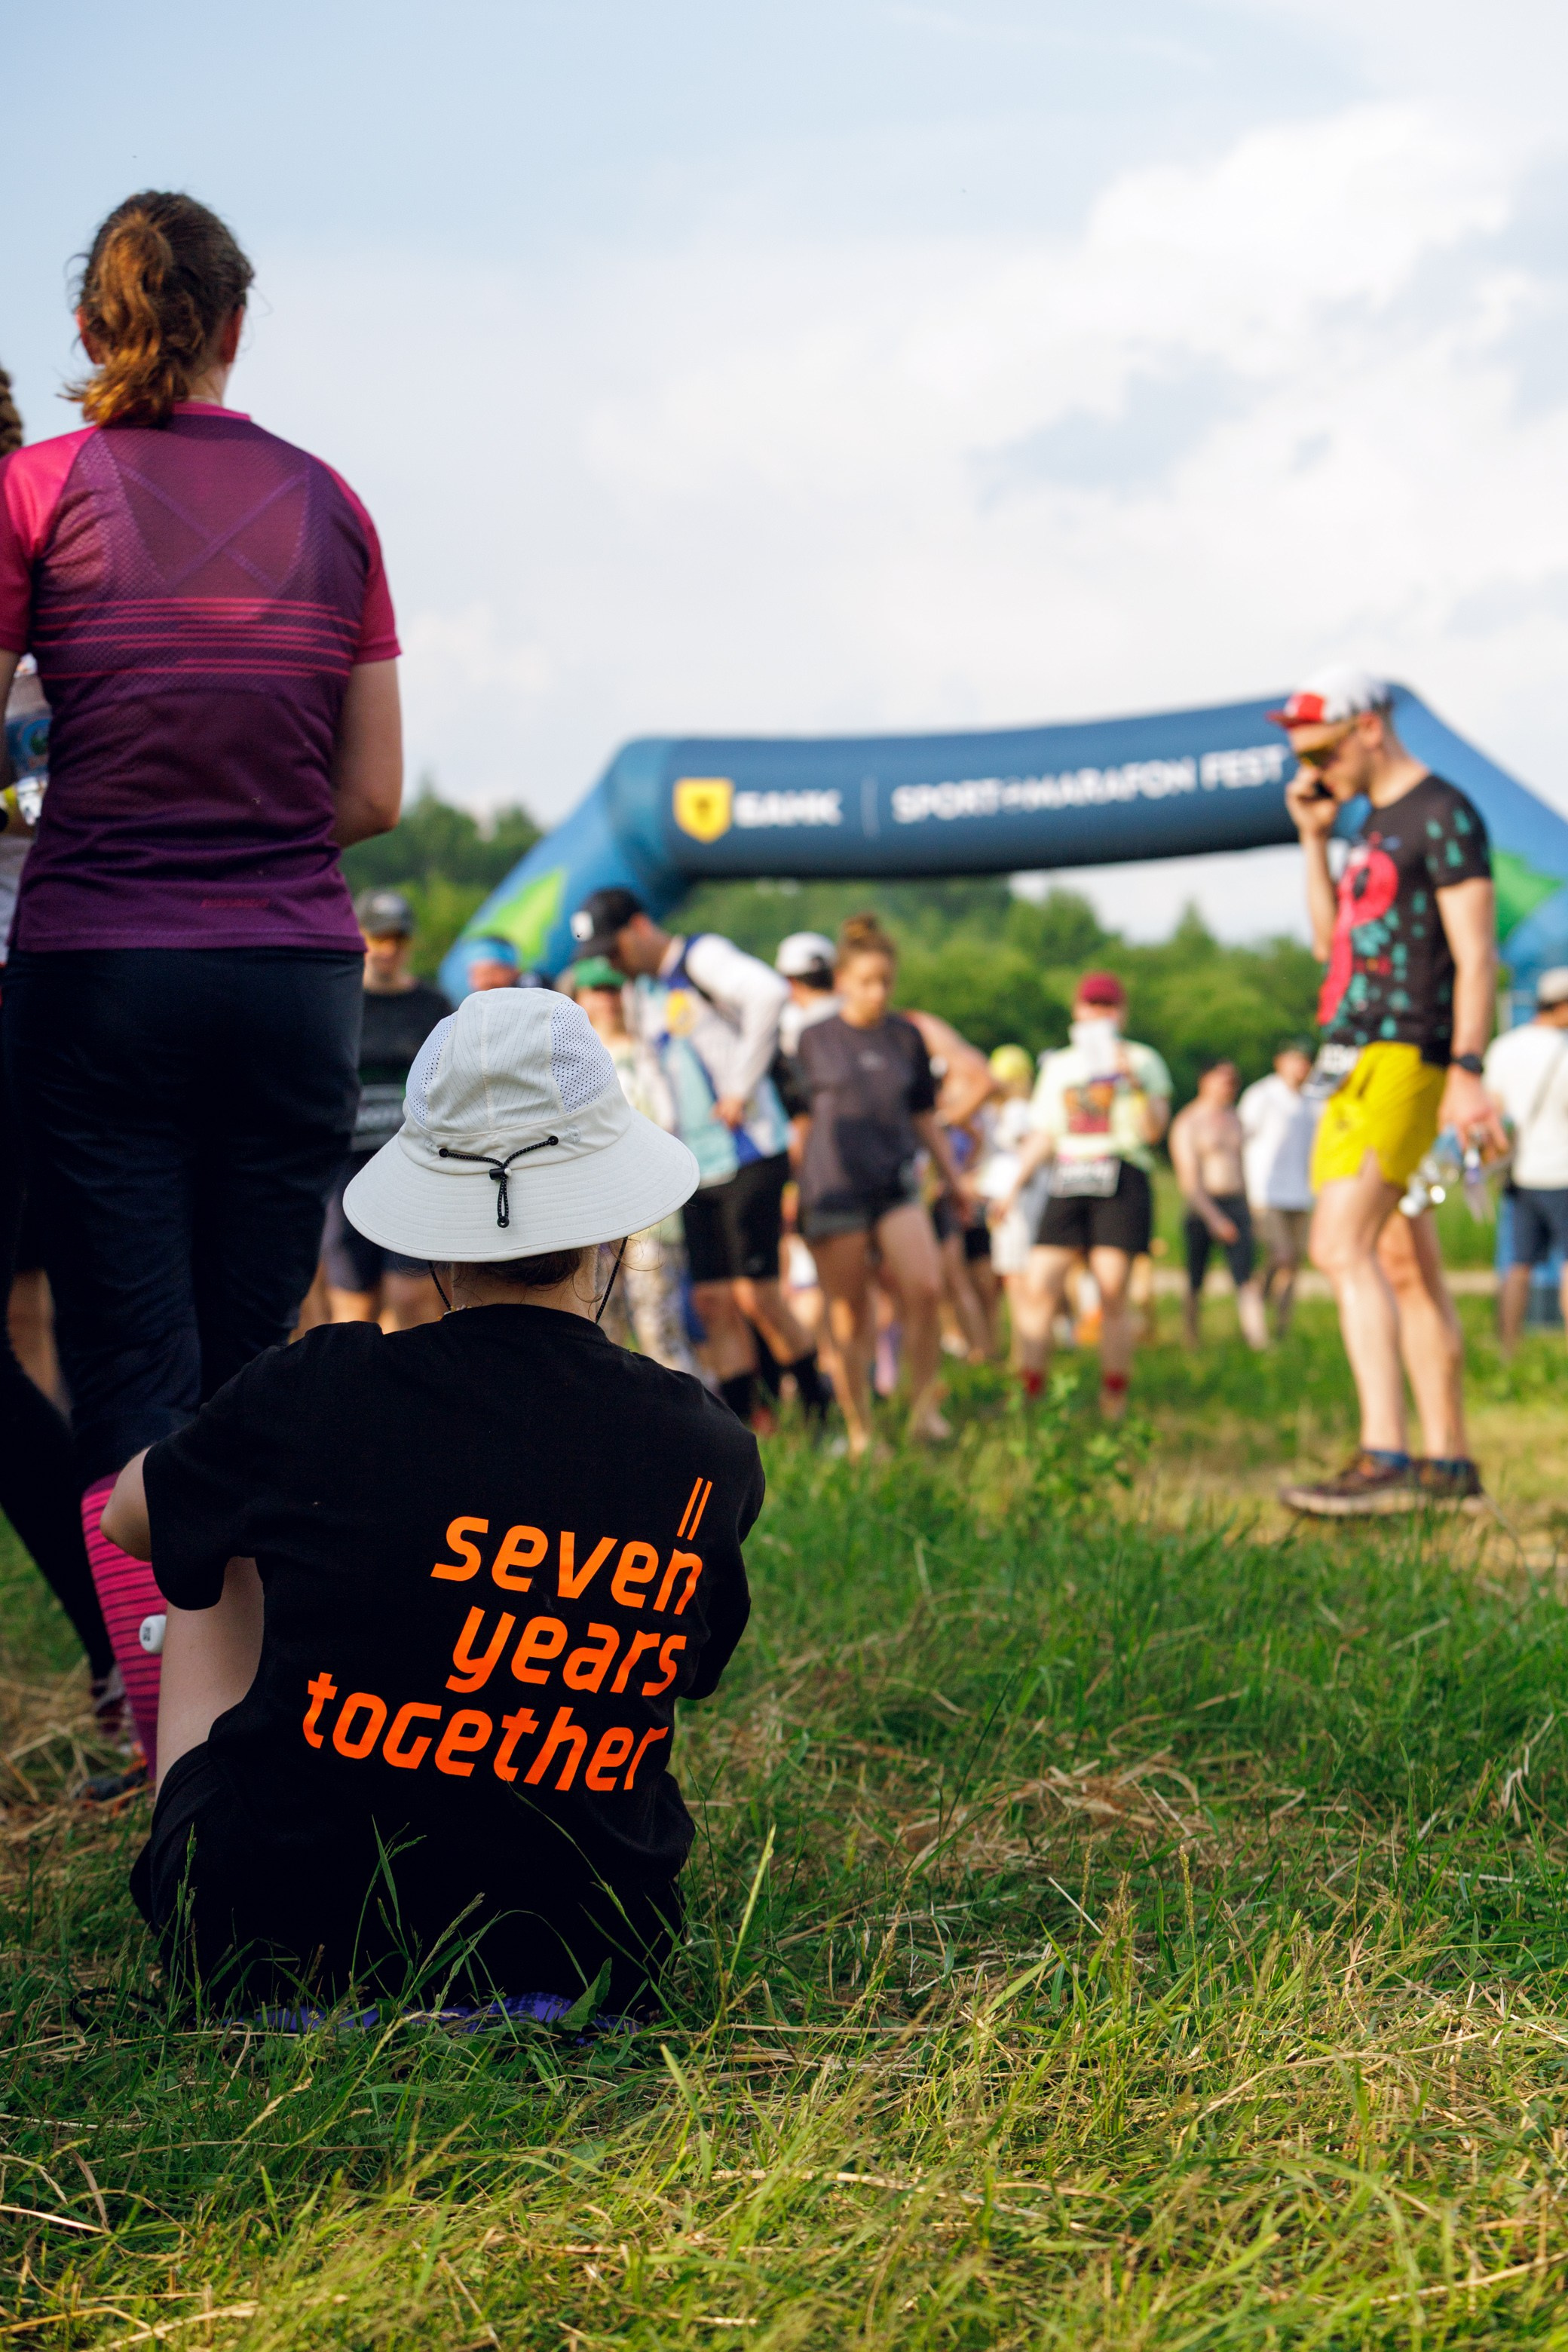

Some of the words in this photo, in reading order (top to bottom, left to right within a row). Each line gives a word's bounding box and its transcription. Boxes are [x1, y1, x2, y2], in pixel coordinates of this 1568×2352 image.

[1201, 744, 1288, 792] FEST
[430, 1516, 703, 1615] seven
[446, 1606, 687, 1695] years
